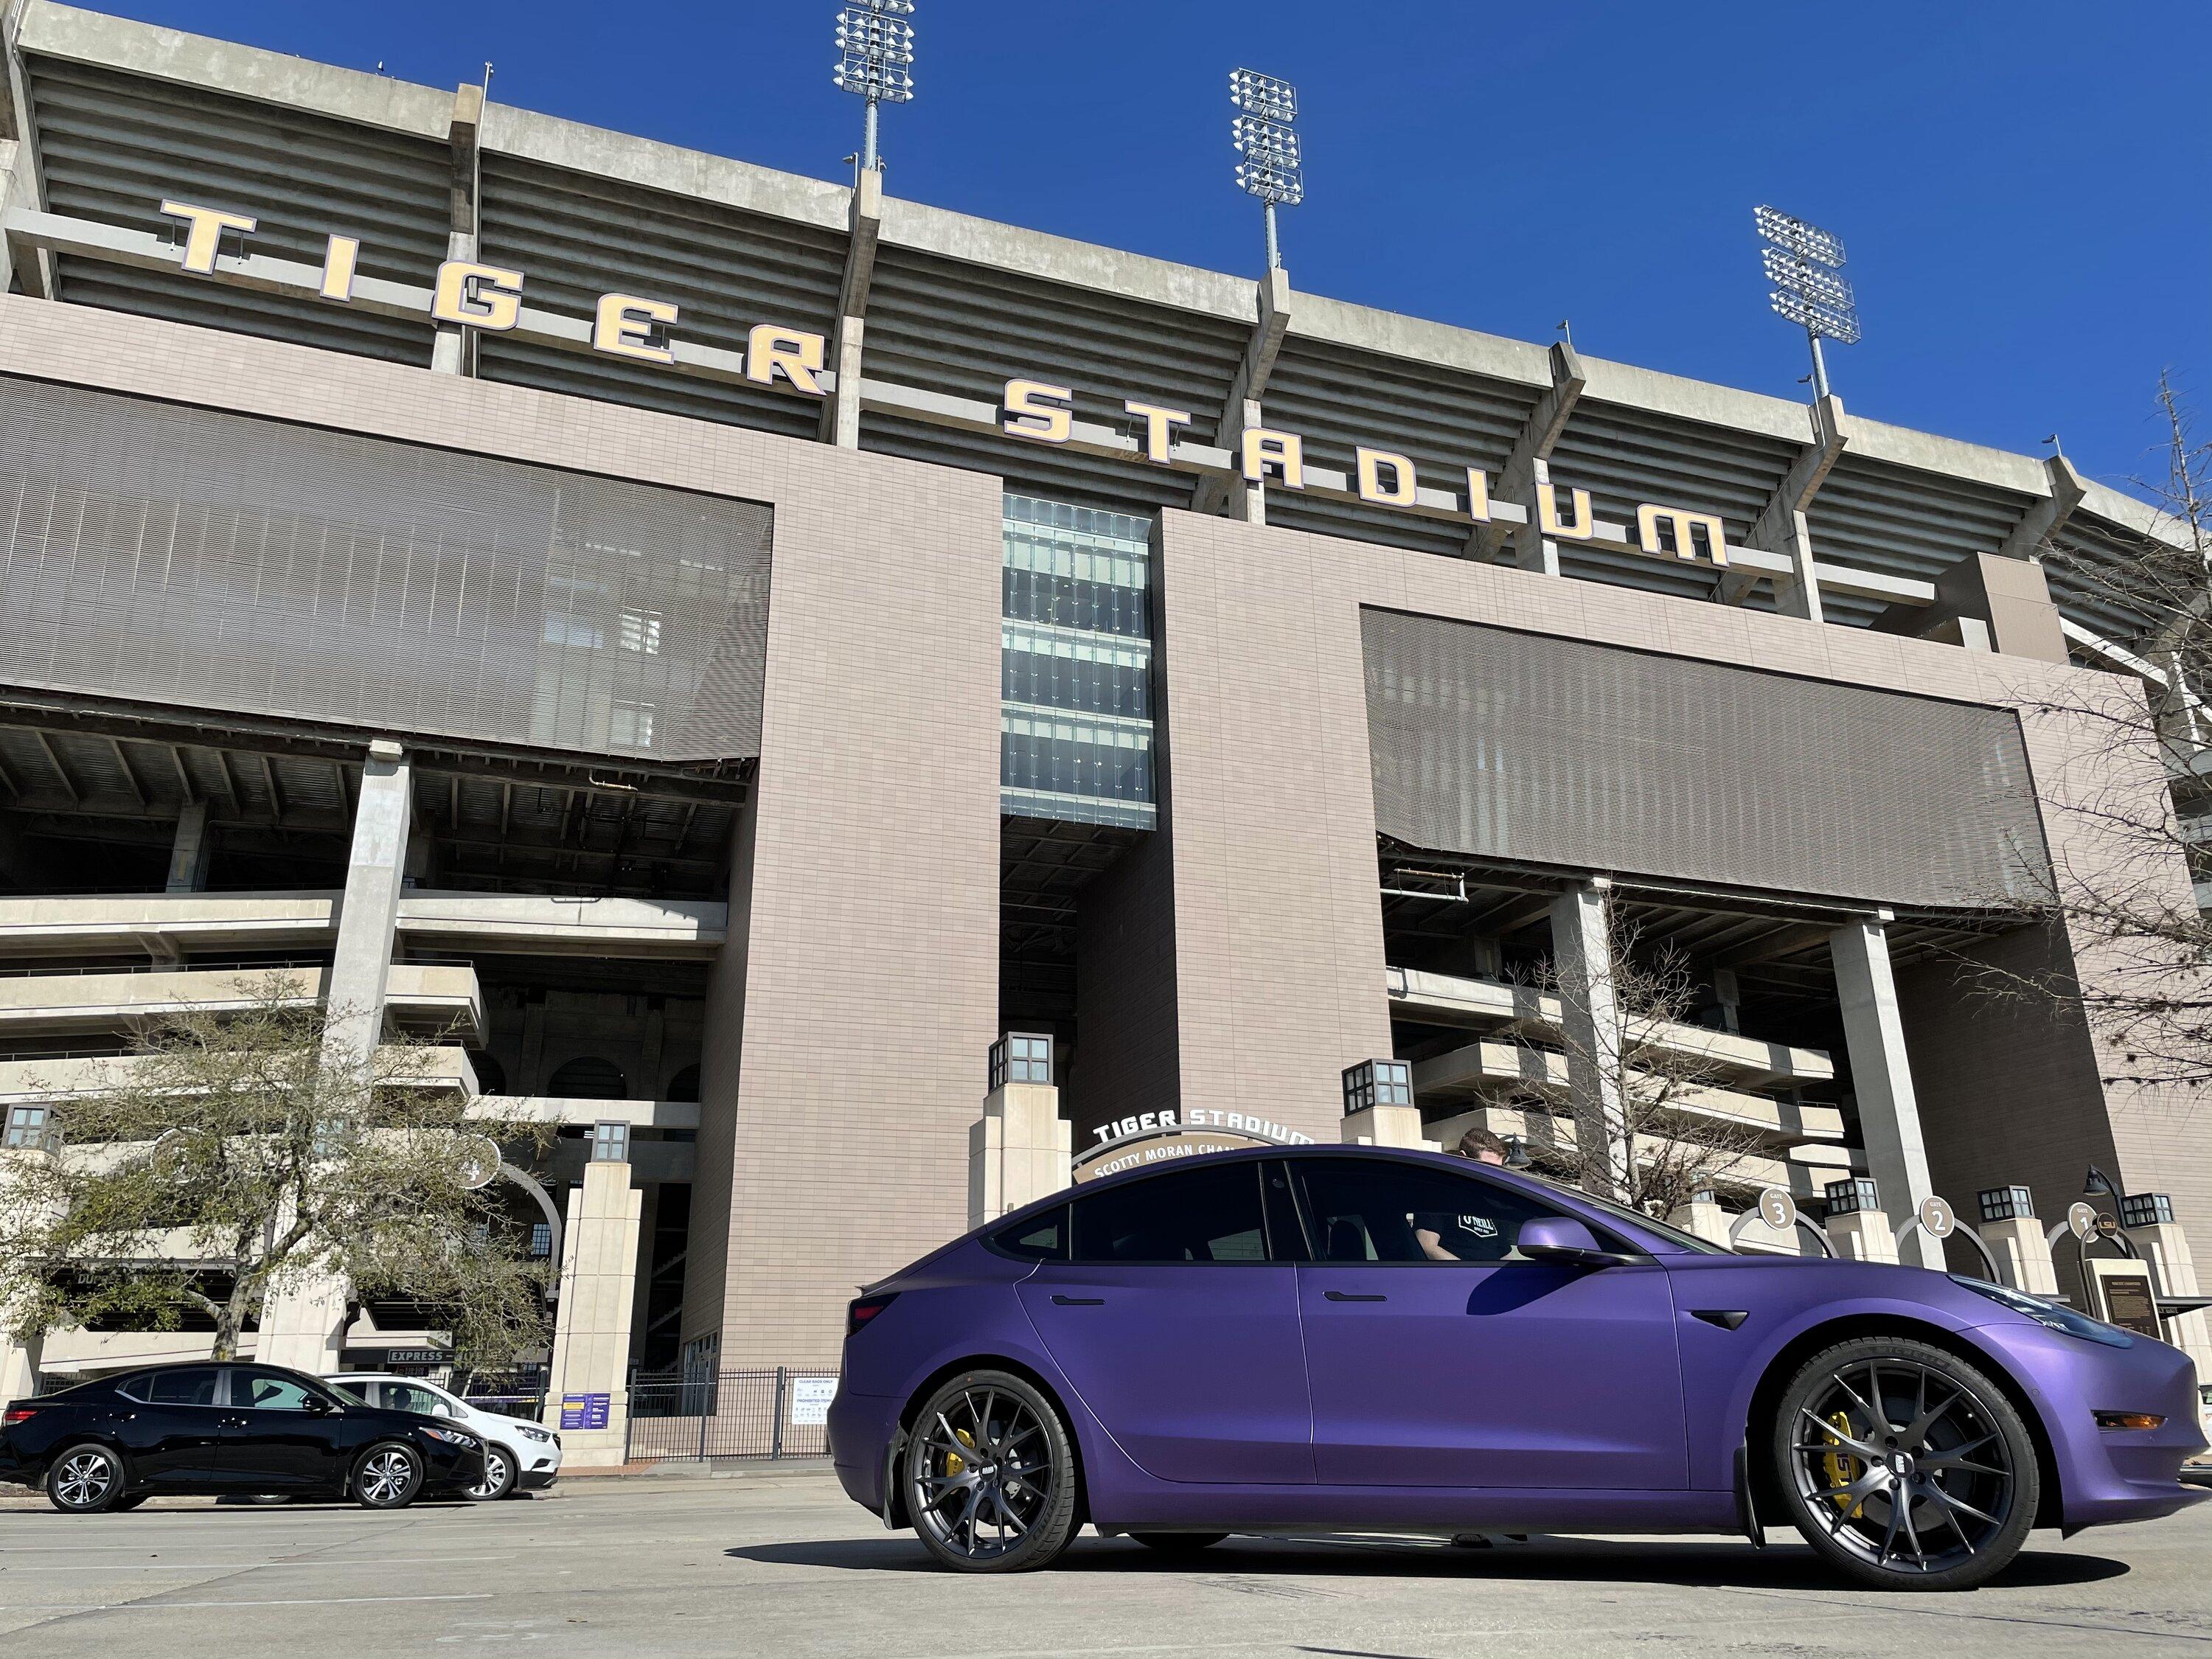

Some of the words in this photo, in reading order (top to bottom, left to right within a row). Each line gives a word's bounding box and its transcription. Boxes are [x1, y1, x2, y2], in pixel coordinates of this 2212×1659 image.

[160, 198, 827, 396] TIGER
[1004, 378, 1730, 568] STADIUM
[1093, 1109, 1178, 1144] TIGER
[1189, 1108, 1315, 1145] STADIUM
[1094, 1152, 1141, 1178] SCOTTY
[1145, 1144, 1193, 1162] MORAN
[1771, 1202, 1787, 1225] 3
[1931, 1210, 1946, 1231] 2
[2079, 1217, 2089, 1231] 1
[2098, 1221, 2116, 1229] LSU
[391, 1352, 442, 1361] EXPRESS
